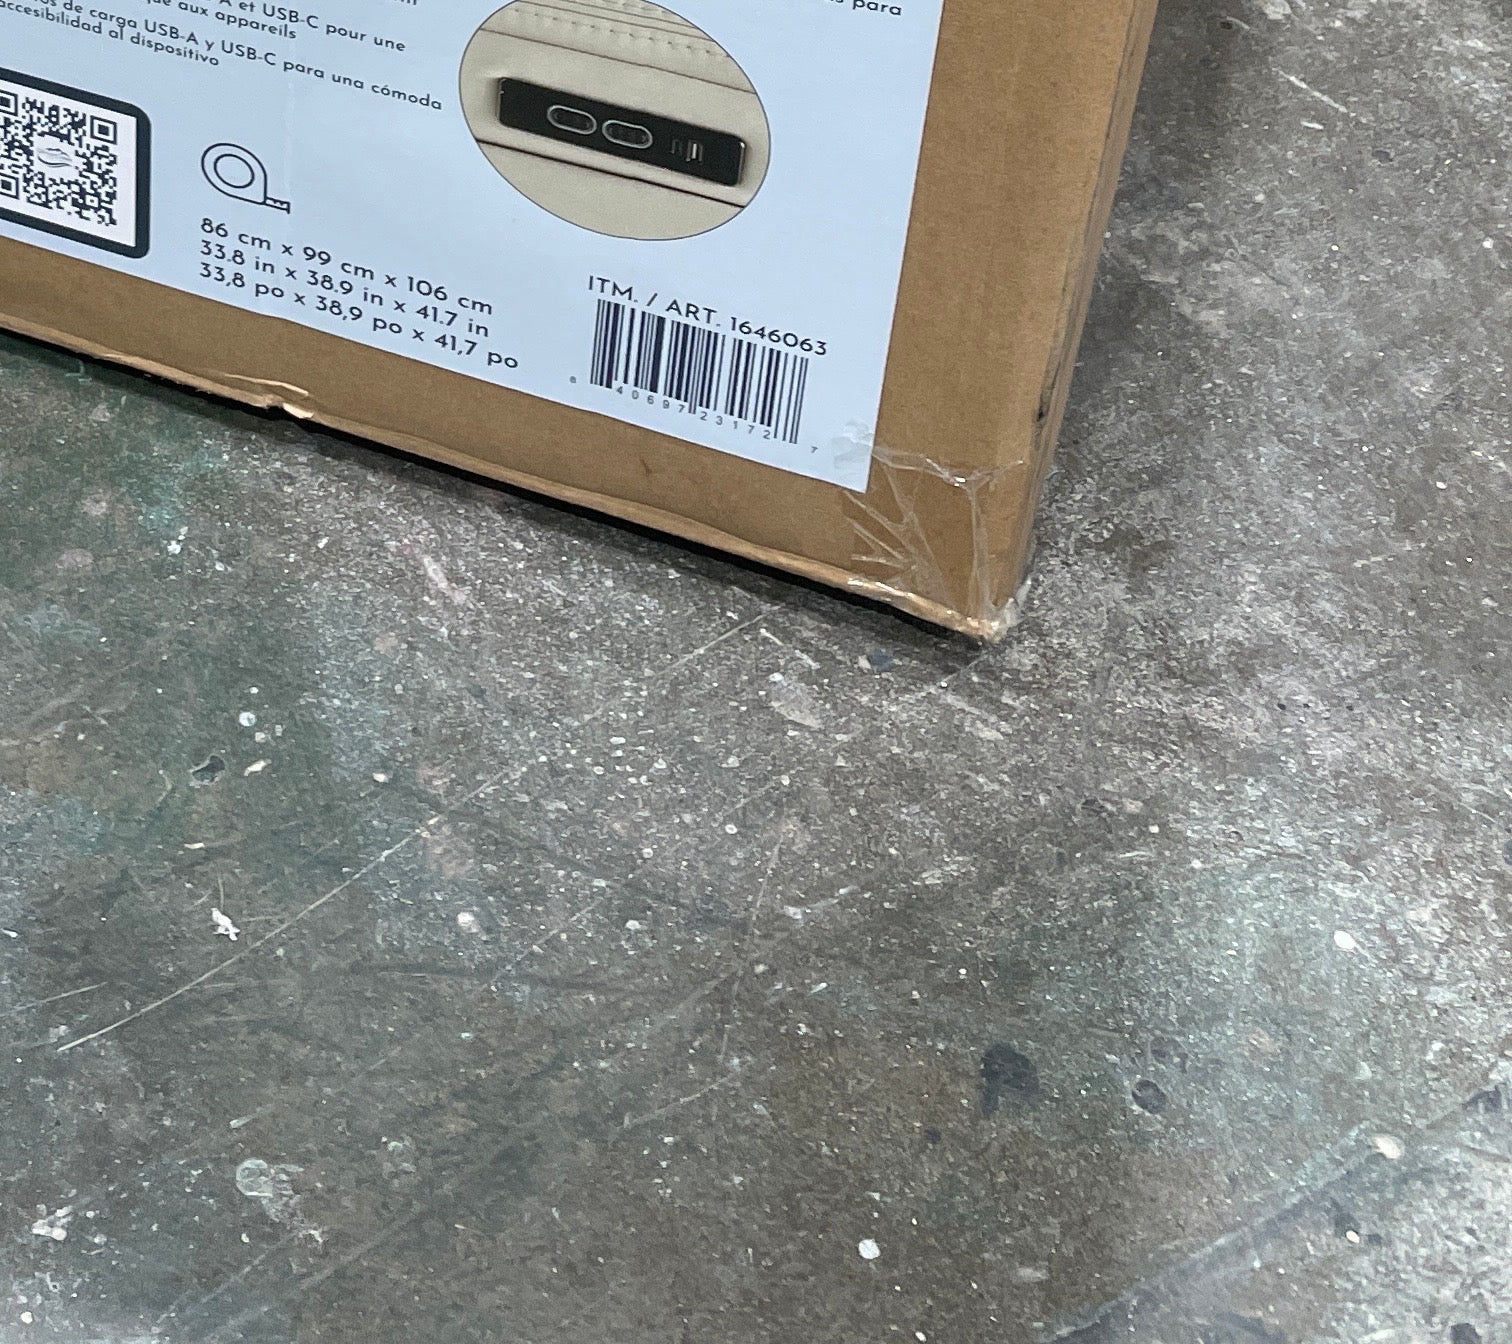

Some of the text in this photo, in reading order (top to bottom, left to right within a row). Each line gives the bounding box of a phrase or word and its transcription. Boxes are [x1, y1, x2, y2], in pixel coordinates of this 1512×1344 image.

[200, 217, 492, 315] 86 cm x 99 cm x 106 cm
[588, 275, 827, 356] ITM. / ART. 1646063
